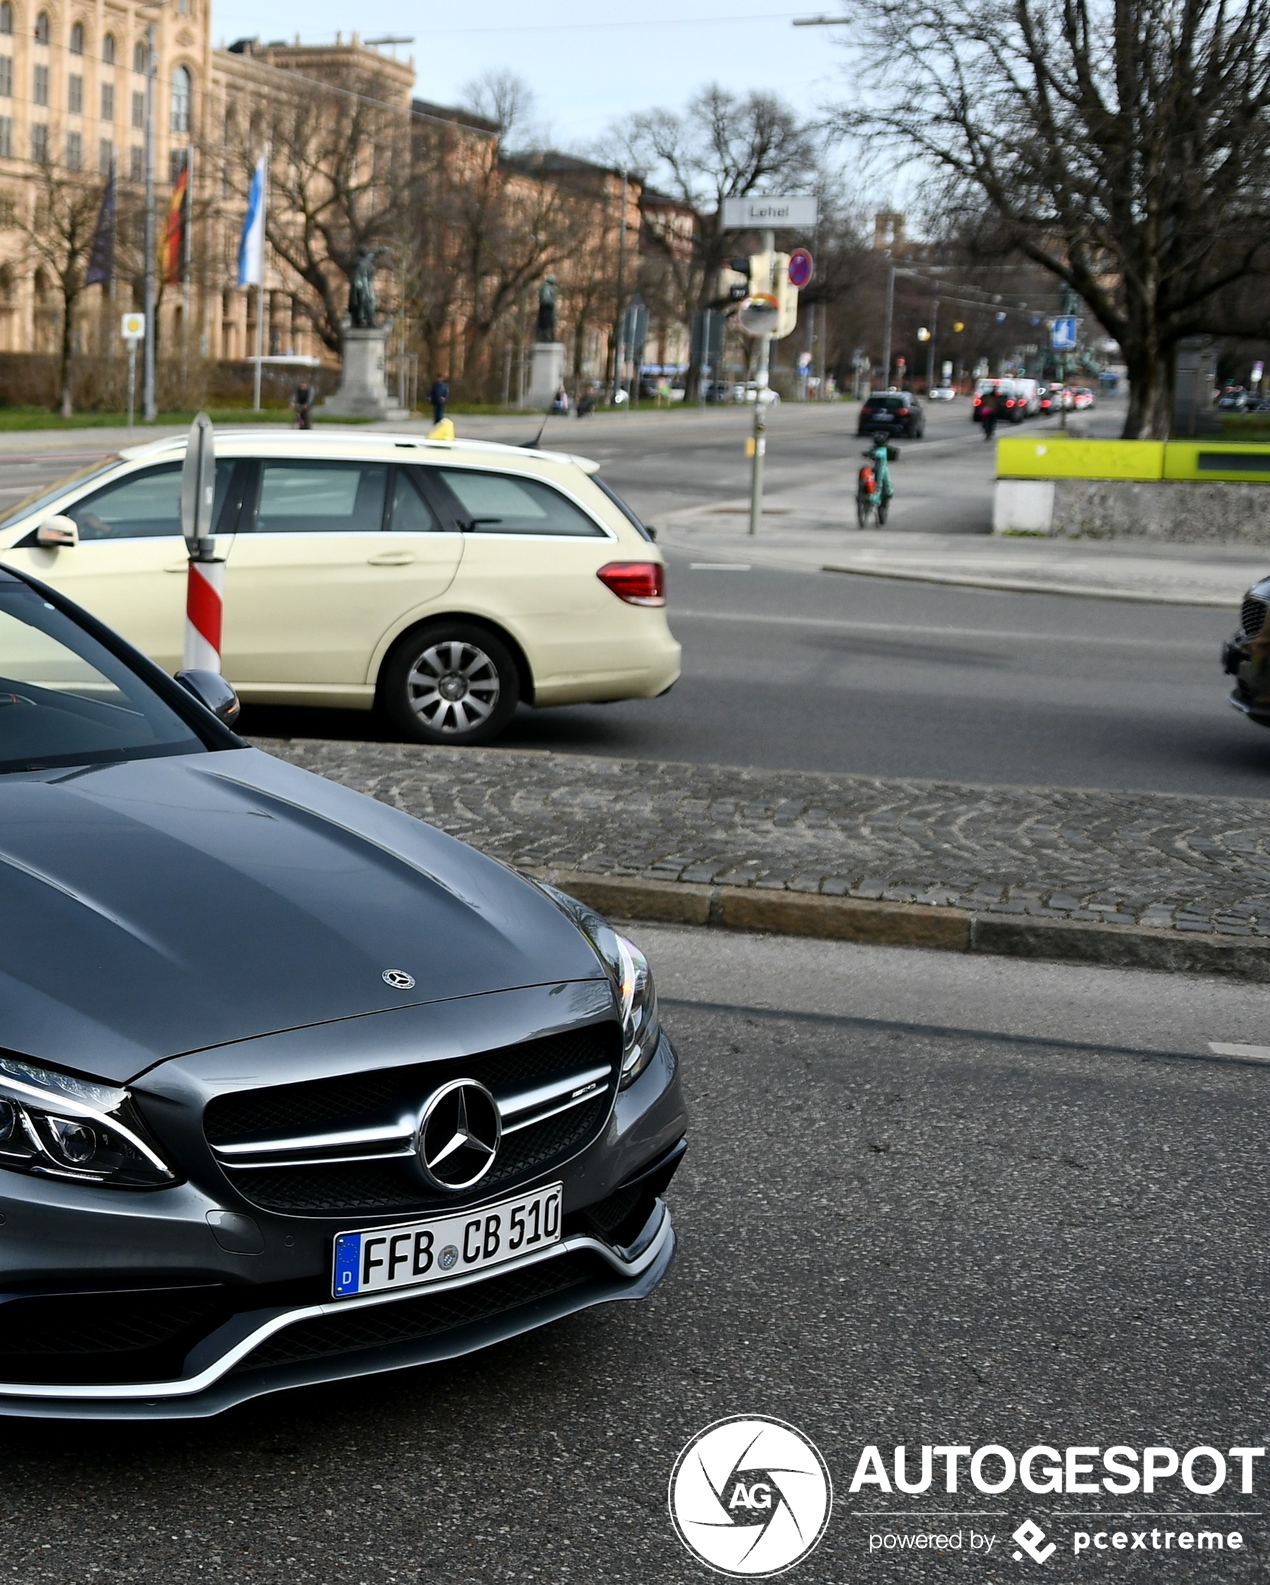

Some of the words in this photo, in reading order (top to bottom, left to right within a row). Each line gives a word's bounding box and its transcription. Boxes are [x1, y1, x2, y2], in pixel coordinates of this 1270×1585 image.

[750, 204, 789, 217] Lehel
[362, 1230, 435, 1285] FFB
[462, 1213, 501, 1264] CB
[508, 1193, 560, 1250] 510
[342, 1271, 352, 1285] D
